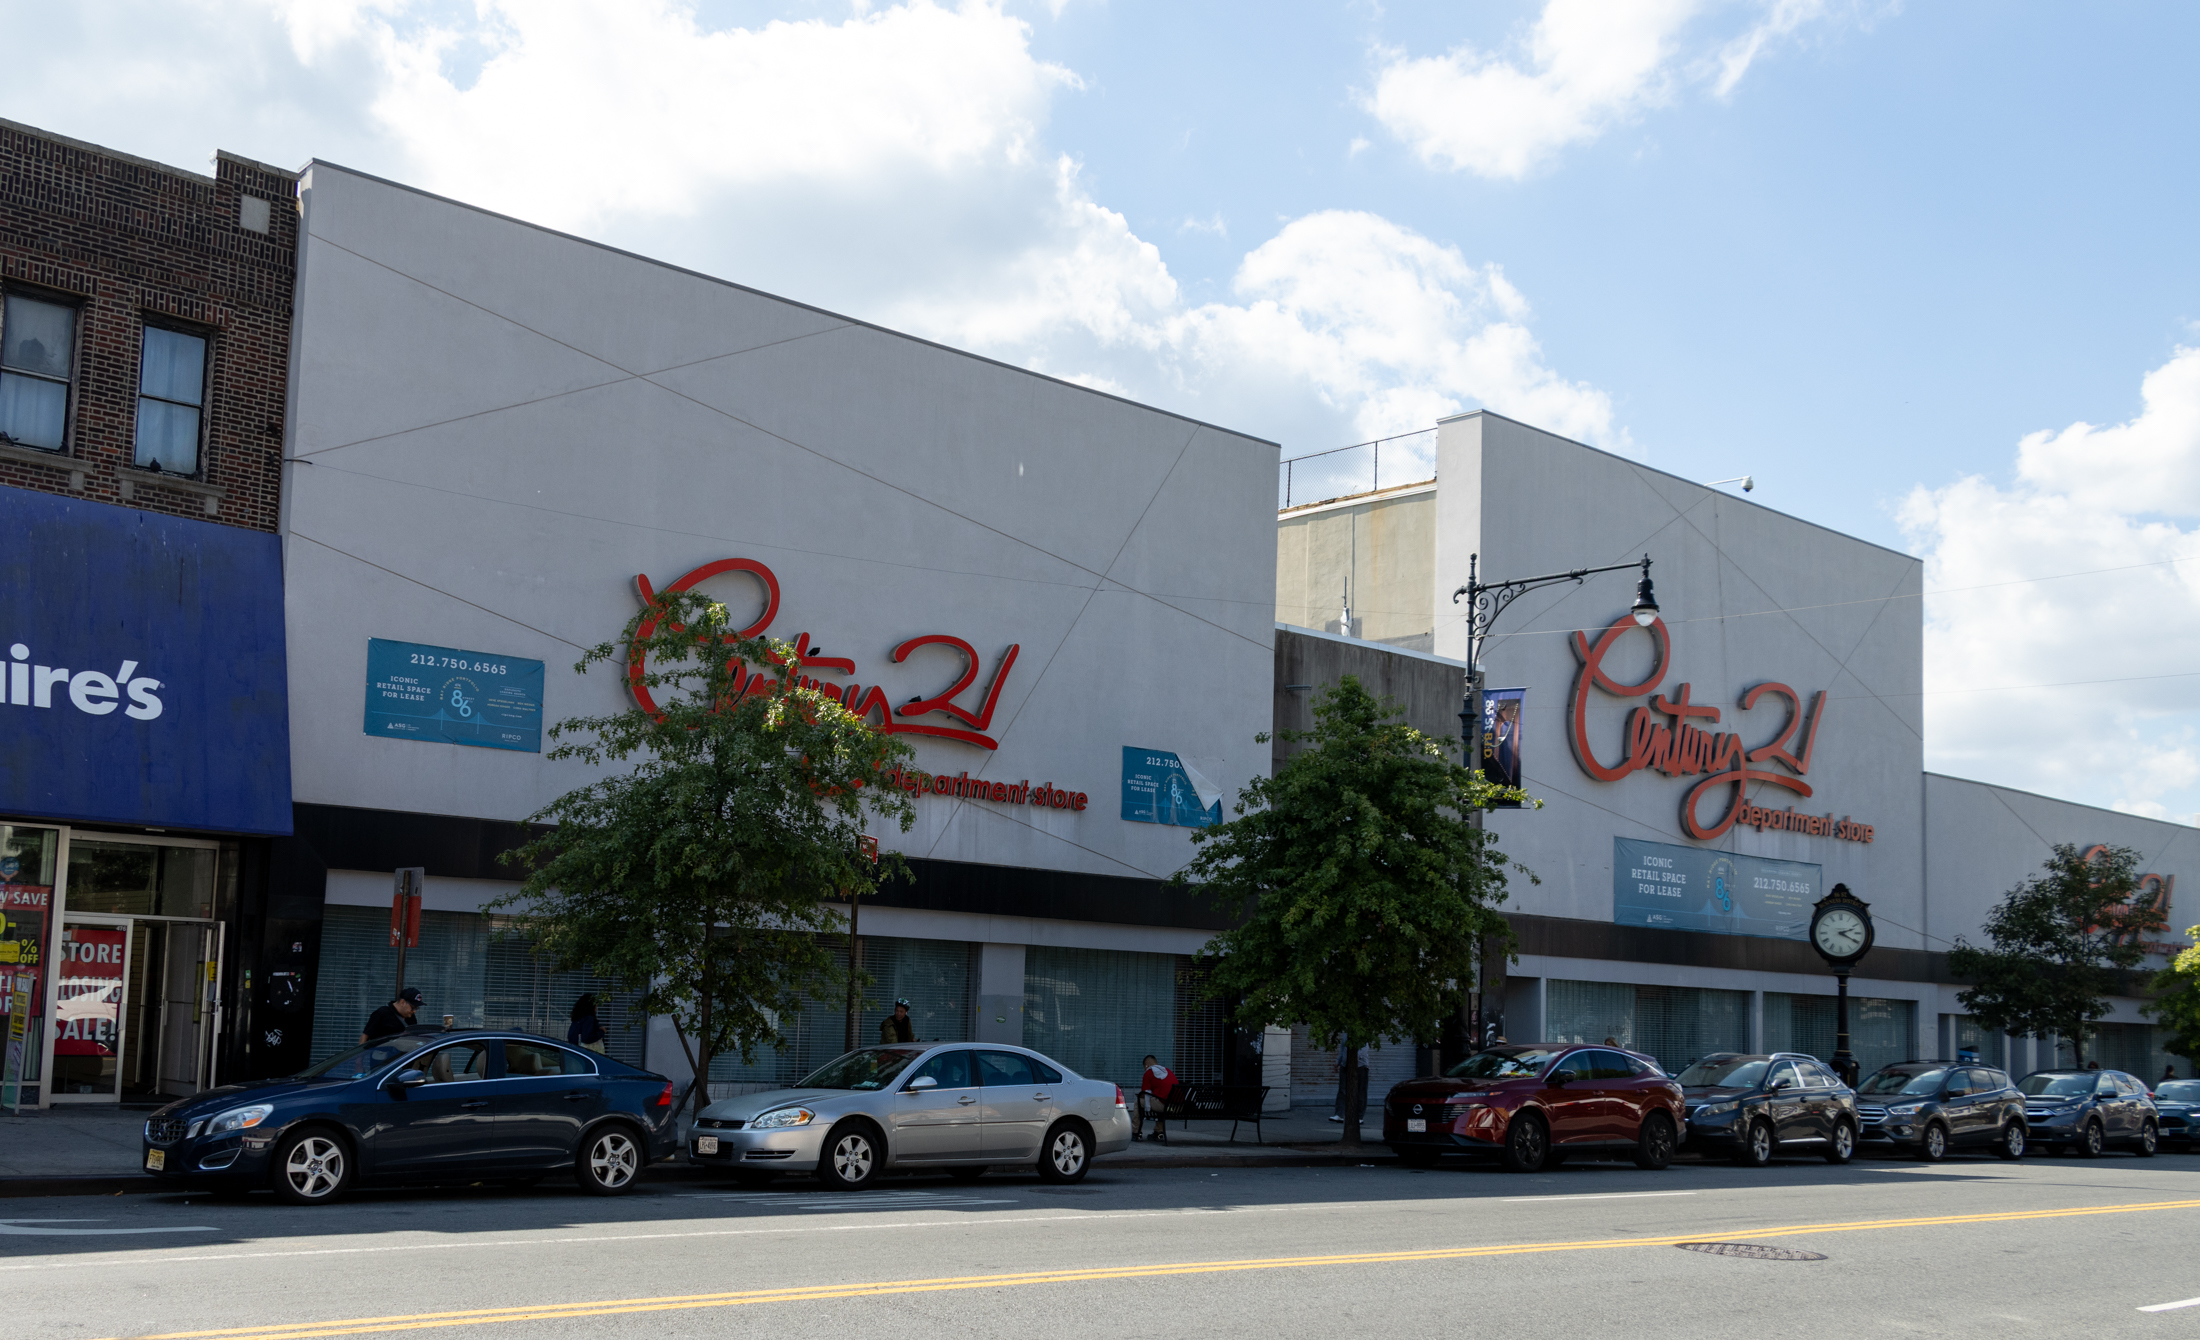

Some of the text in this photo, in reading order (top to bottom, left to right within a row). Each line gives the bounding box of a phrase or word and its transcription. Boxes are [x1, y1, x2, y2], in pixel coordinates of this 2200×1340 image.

[410, 653, 508, 675] 212.750.6565
[0, 643, 163, 720] ire's
[390, 675, 419, 685] ICONIC
[889, 634, 1020, 732] 21
[376, 682, 432, 695] RETAIL SPACE
[382, 691, 425, 702] FOR LEASE
[451, 689, 472, 717] 86
[1484, 717, 1495, 730] St
[1571, 613, 1827, 840] Century 21
[501, 733, 522, 741] RIPCO
[1135, 773, 1152, 781] ICONIC
[883, 762, 1089, 812] department store
[1737, 800, 1875, 843] department store
[1643, 855, 1673, 869] ICONIC
[1631, 868, 1687, 885] RETAIL SPACE
[1638, 883, 1682, 898] FOR LEASE
[1753, 877, 1810, 894] 212.750.6565
[13, 892, 48, 905] SAVE
[1715, 876, 1731, 912] 86
[1842, 898, 1865, 909] DISTRICT
[19, 953, 39, 965] OFF
[60, 975, 121, 1003] LOSING
